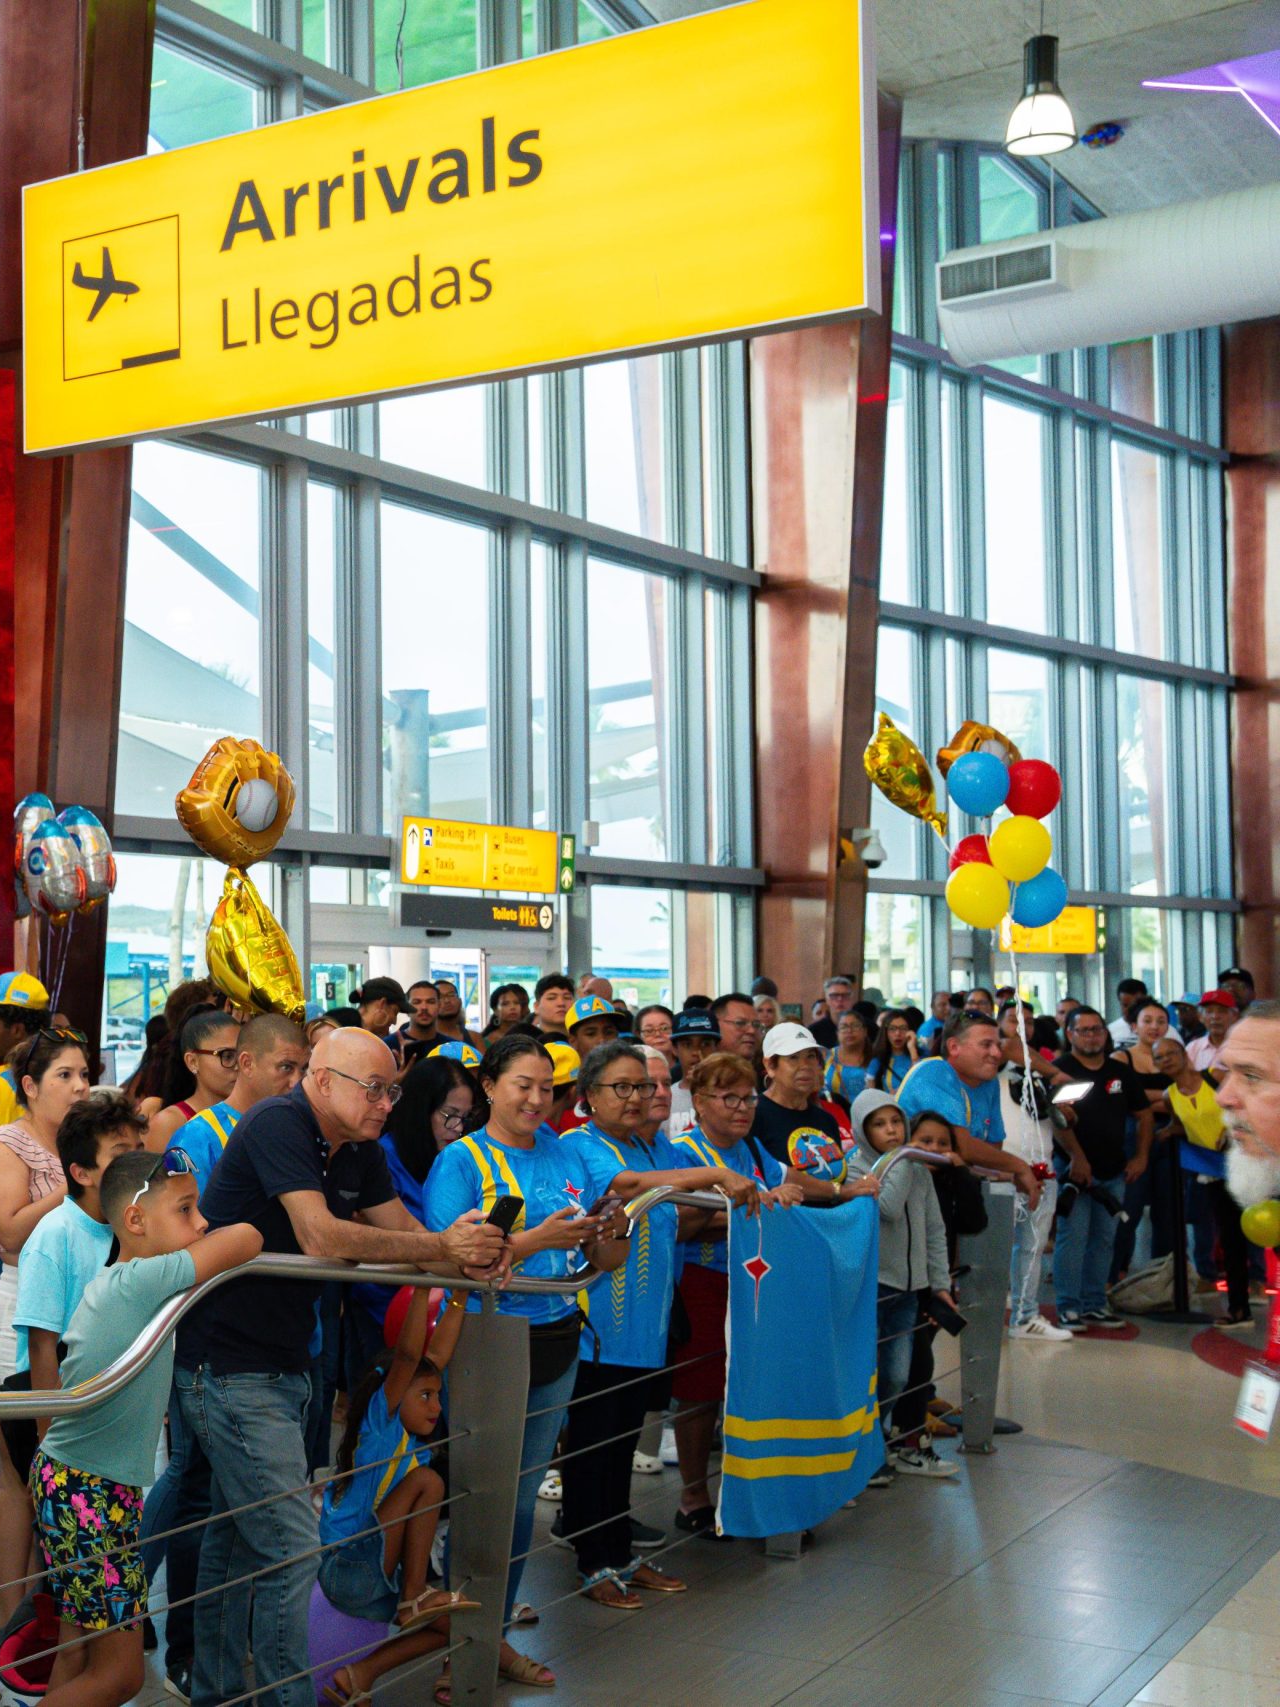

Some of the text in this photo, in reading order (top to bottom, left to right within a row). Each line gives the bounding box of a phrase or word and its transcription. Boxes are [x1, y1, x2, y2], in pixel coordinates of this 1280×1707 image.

[219, 115, 543, 254] Arrivals
[221, 253, 493, 351] Llegadas
[435, 825, 464, 842] Parking
[503, 832, 524, 845] Buses
[435, 857, 455, 871] Taxis
[503, 863, 539, 877] Car rental
[491, 906, 518, 922] Toilets
[327, 984, 333, 998] 5
